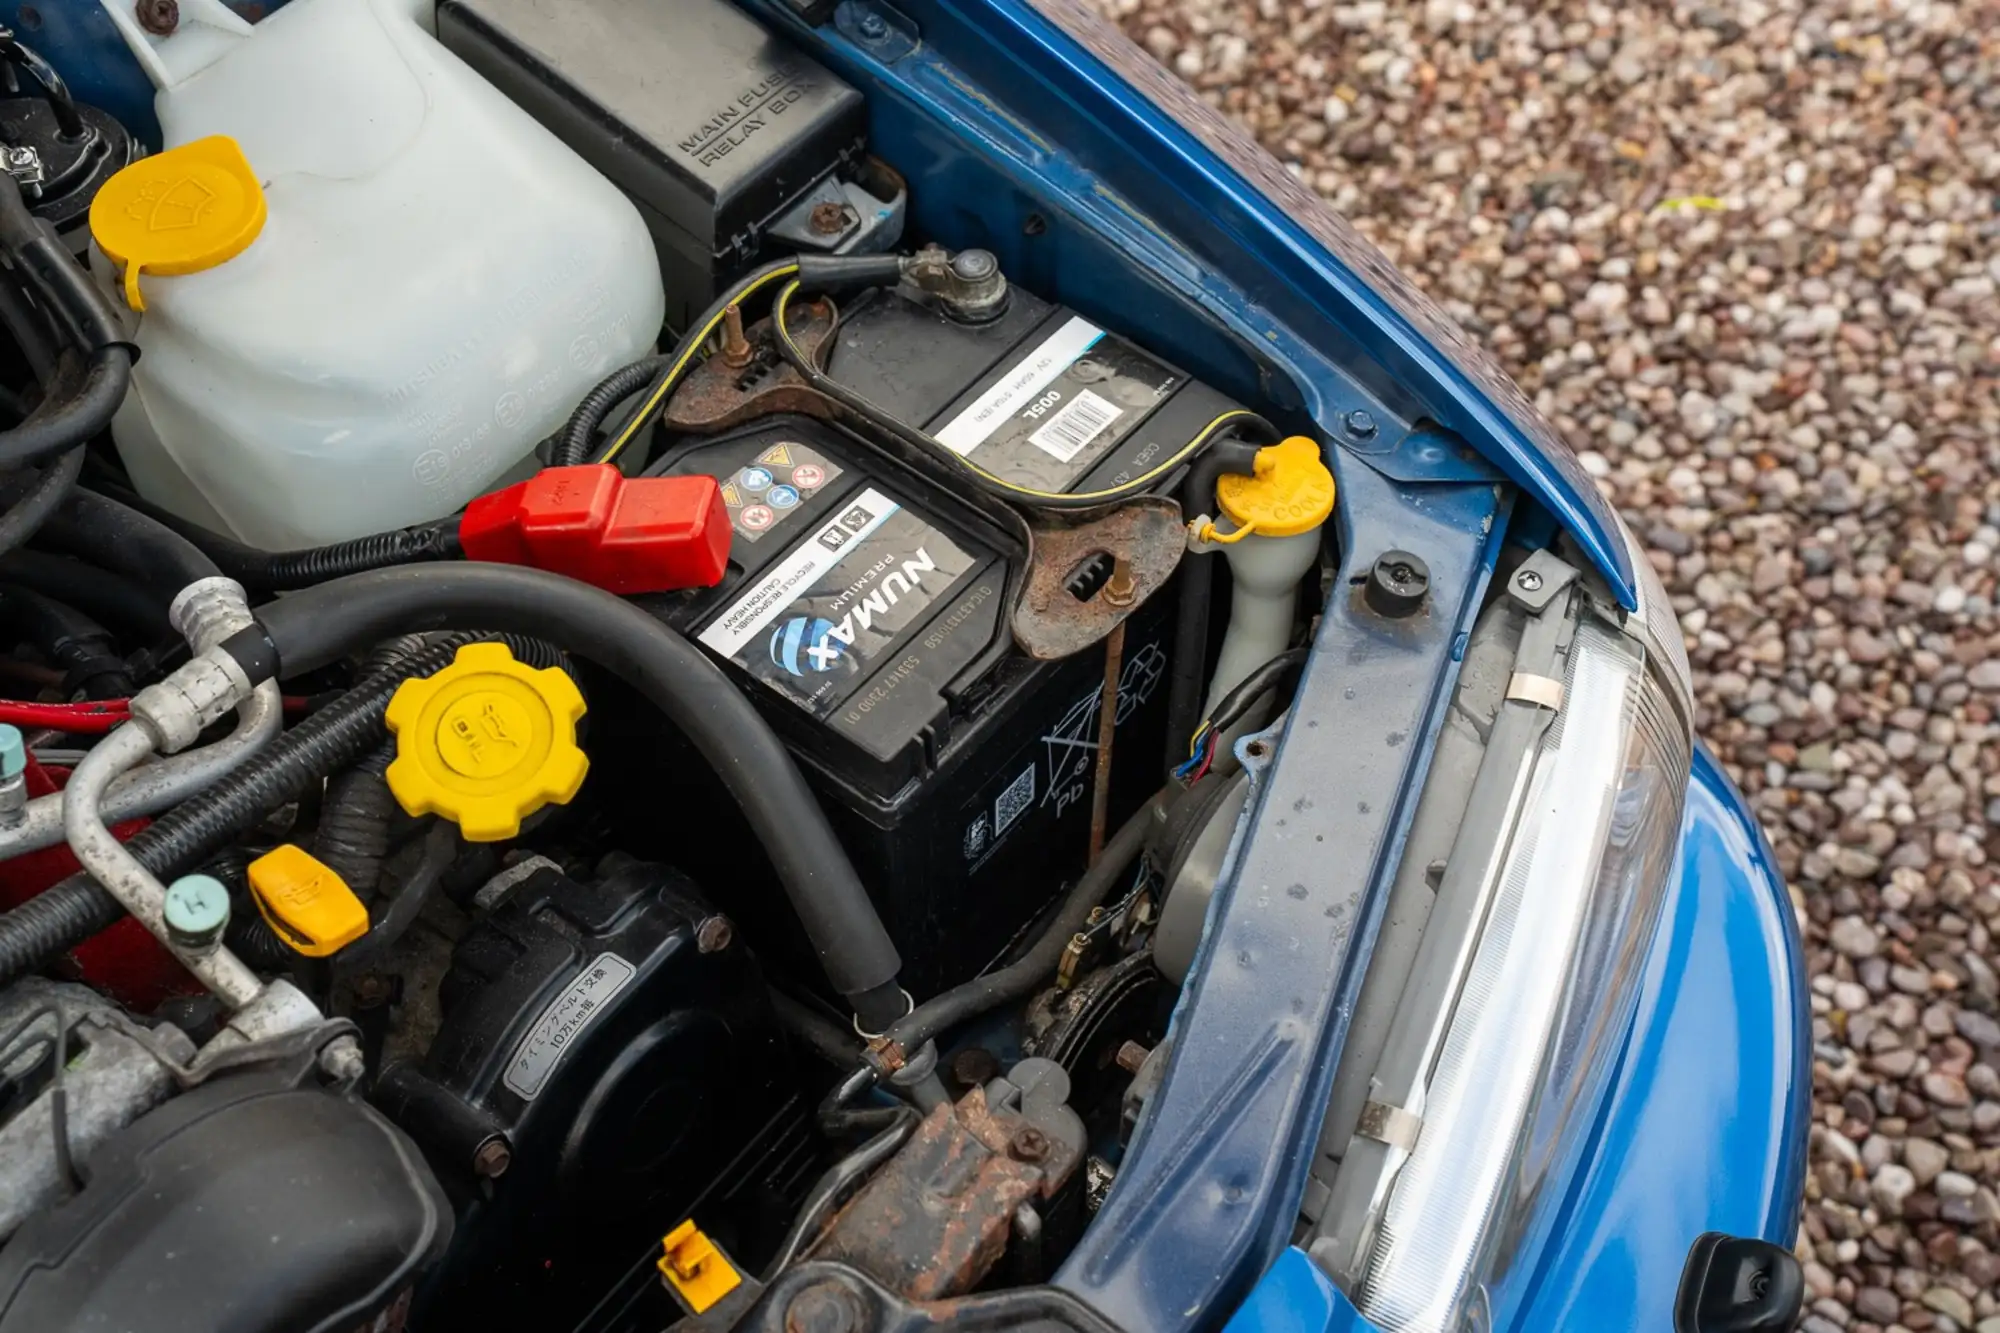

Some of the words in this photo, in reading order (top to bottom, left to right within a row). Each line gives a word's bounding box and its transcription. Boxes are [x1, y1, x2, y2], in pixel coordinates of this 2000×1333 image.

[677, 106, 740, 152] MAIN
[737, 63, 797, 107] FUSE
[699, 113, 766, 167] RELAY
[768, 78, 818, 115] BOX
[1022, 390, 1062, 420] 005L
[746, 577, 781, 608] CAUTION
[779, 560, 815, 592] RECYCLE
[830, 553, 895, 611] PREMIUM
[722, 605, 748, 629] HEAVY
[731, 589, 782, 636] RESPONSIBLY
[807, 546, 936, 671] NUMAX
[1056, 783, 1085, 818] Pb
